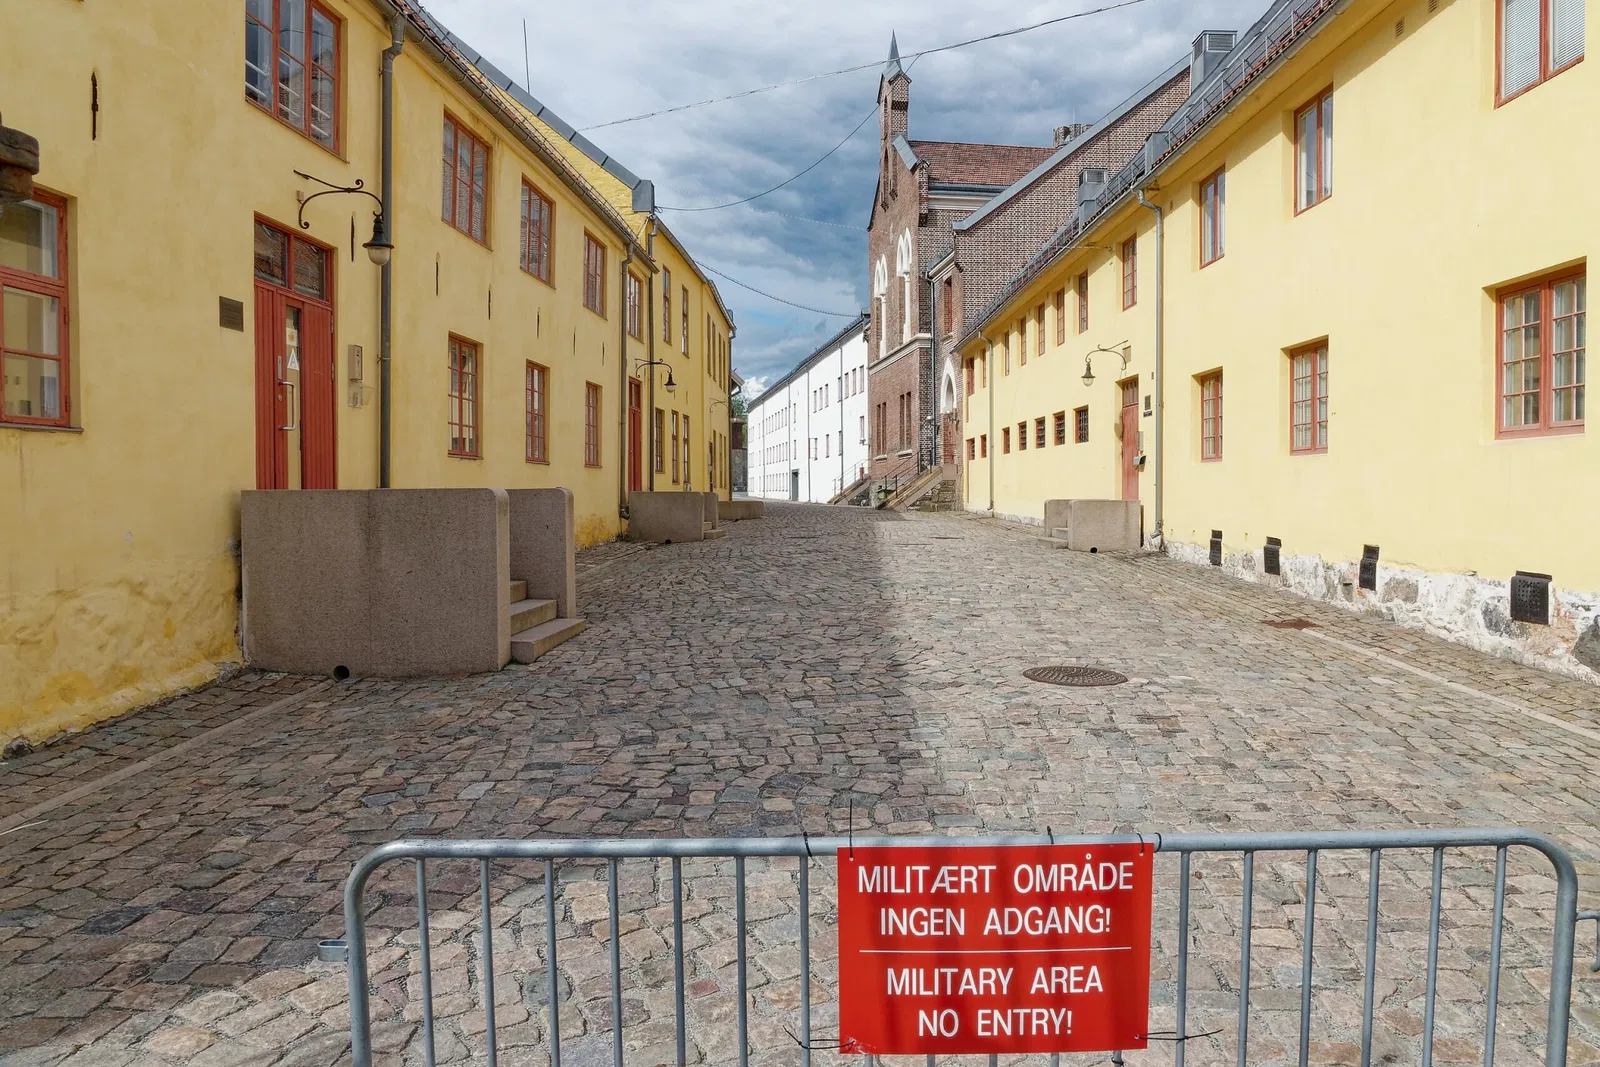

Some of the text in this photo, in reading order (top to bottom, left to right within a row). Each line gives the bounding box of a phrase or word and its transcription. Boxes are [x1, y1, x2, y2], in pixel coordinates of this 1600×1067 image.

[858, 853, 1133, 893] MILITÆRT OMRÅDE
[881, 904, 1111, 936] INGEN ADGANG!
[887, 965, 1104, 996] MILITARY AREA
[918, 1008, 1073, 1038] NO ENTRY!
